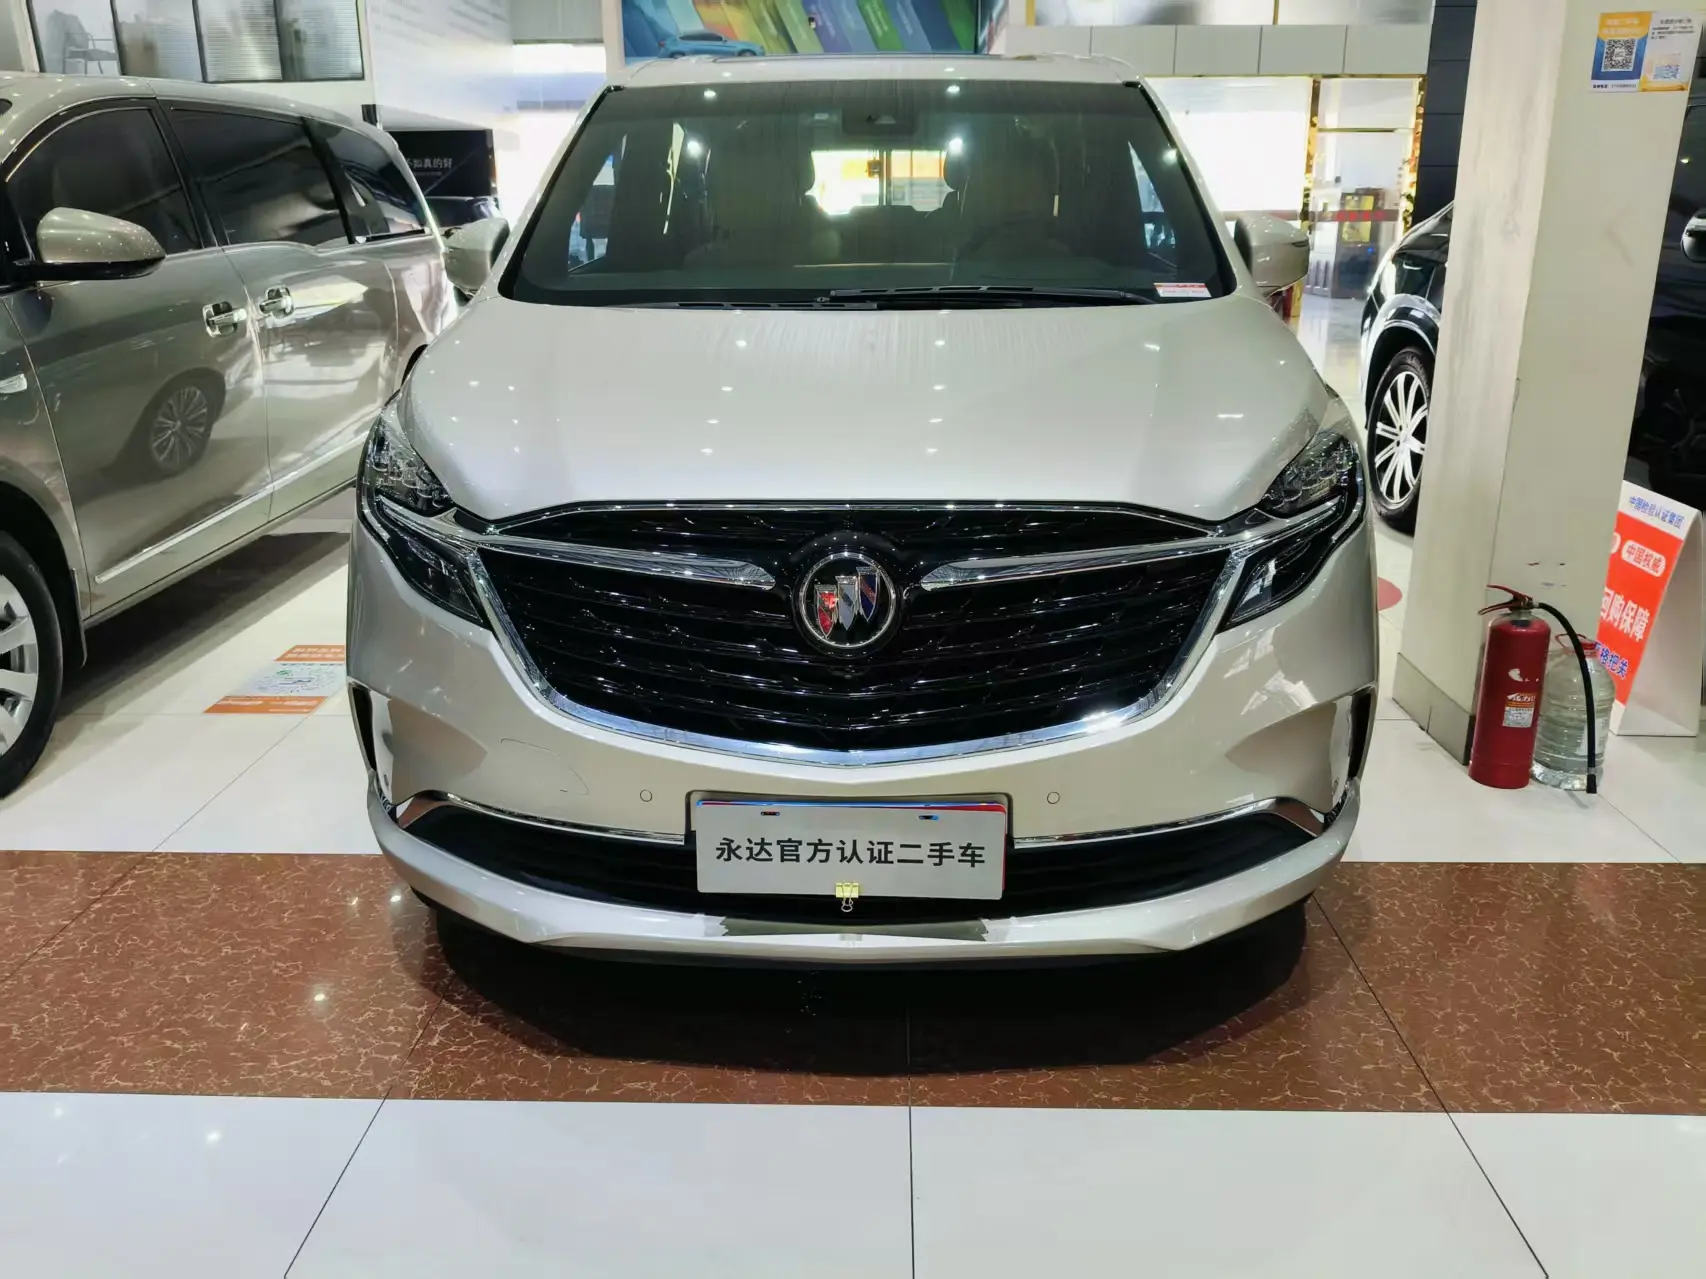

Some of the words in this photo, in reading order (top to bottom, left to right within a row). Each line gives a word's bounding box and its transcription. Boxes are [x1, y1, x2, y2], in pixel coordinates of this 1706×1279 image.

[715, 837, 986, 868] 永达官方认证二手车
